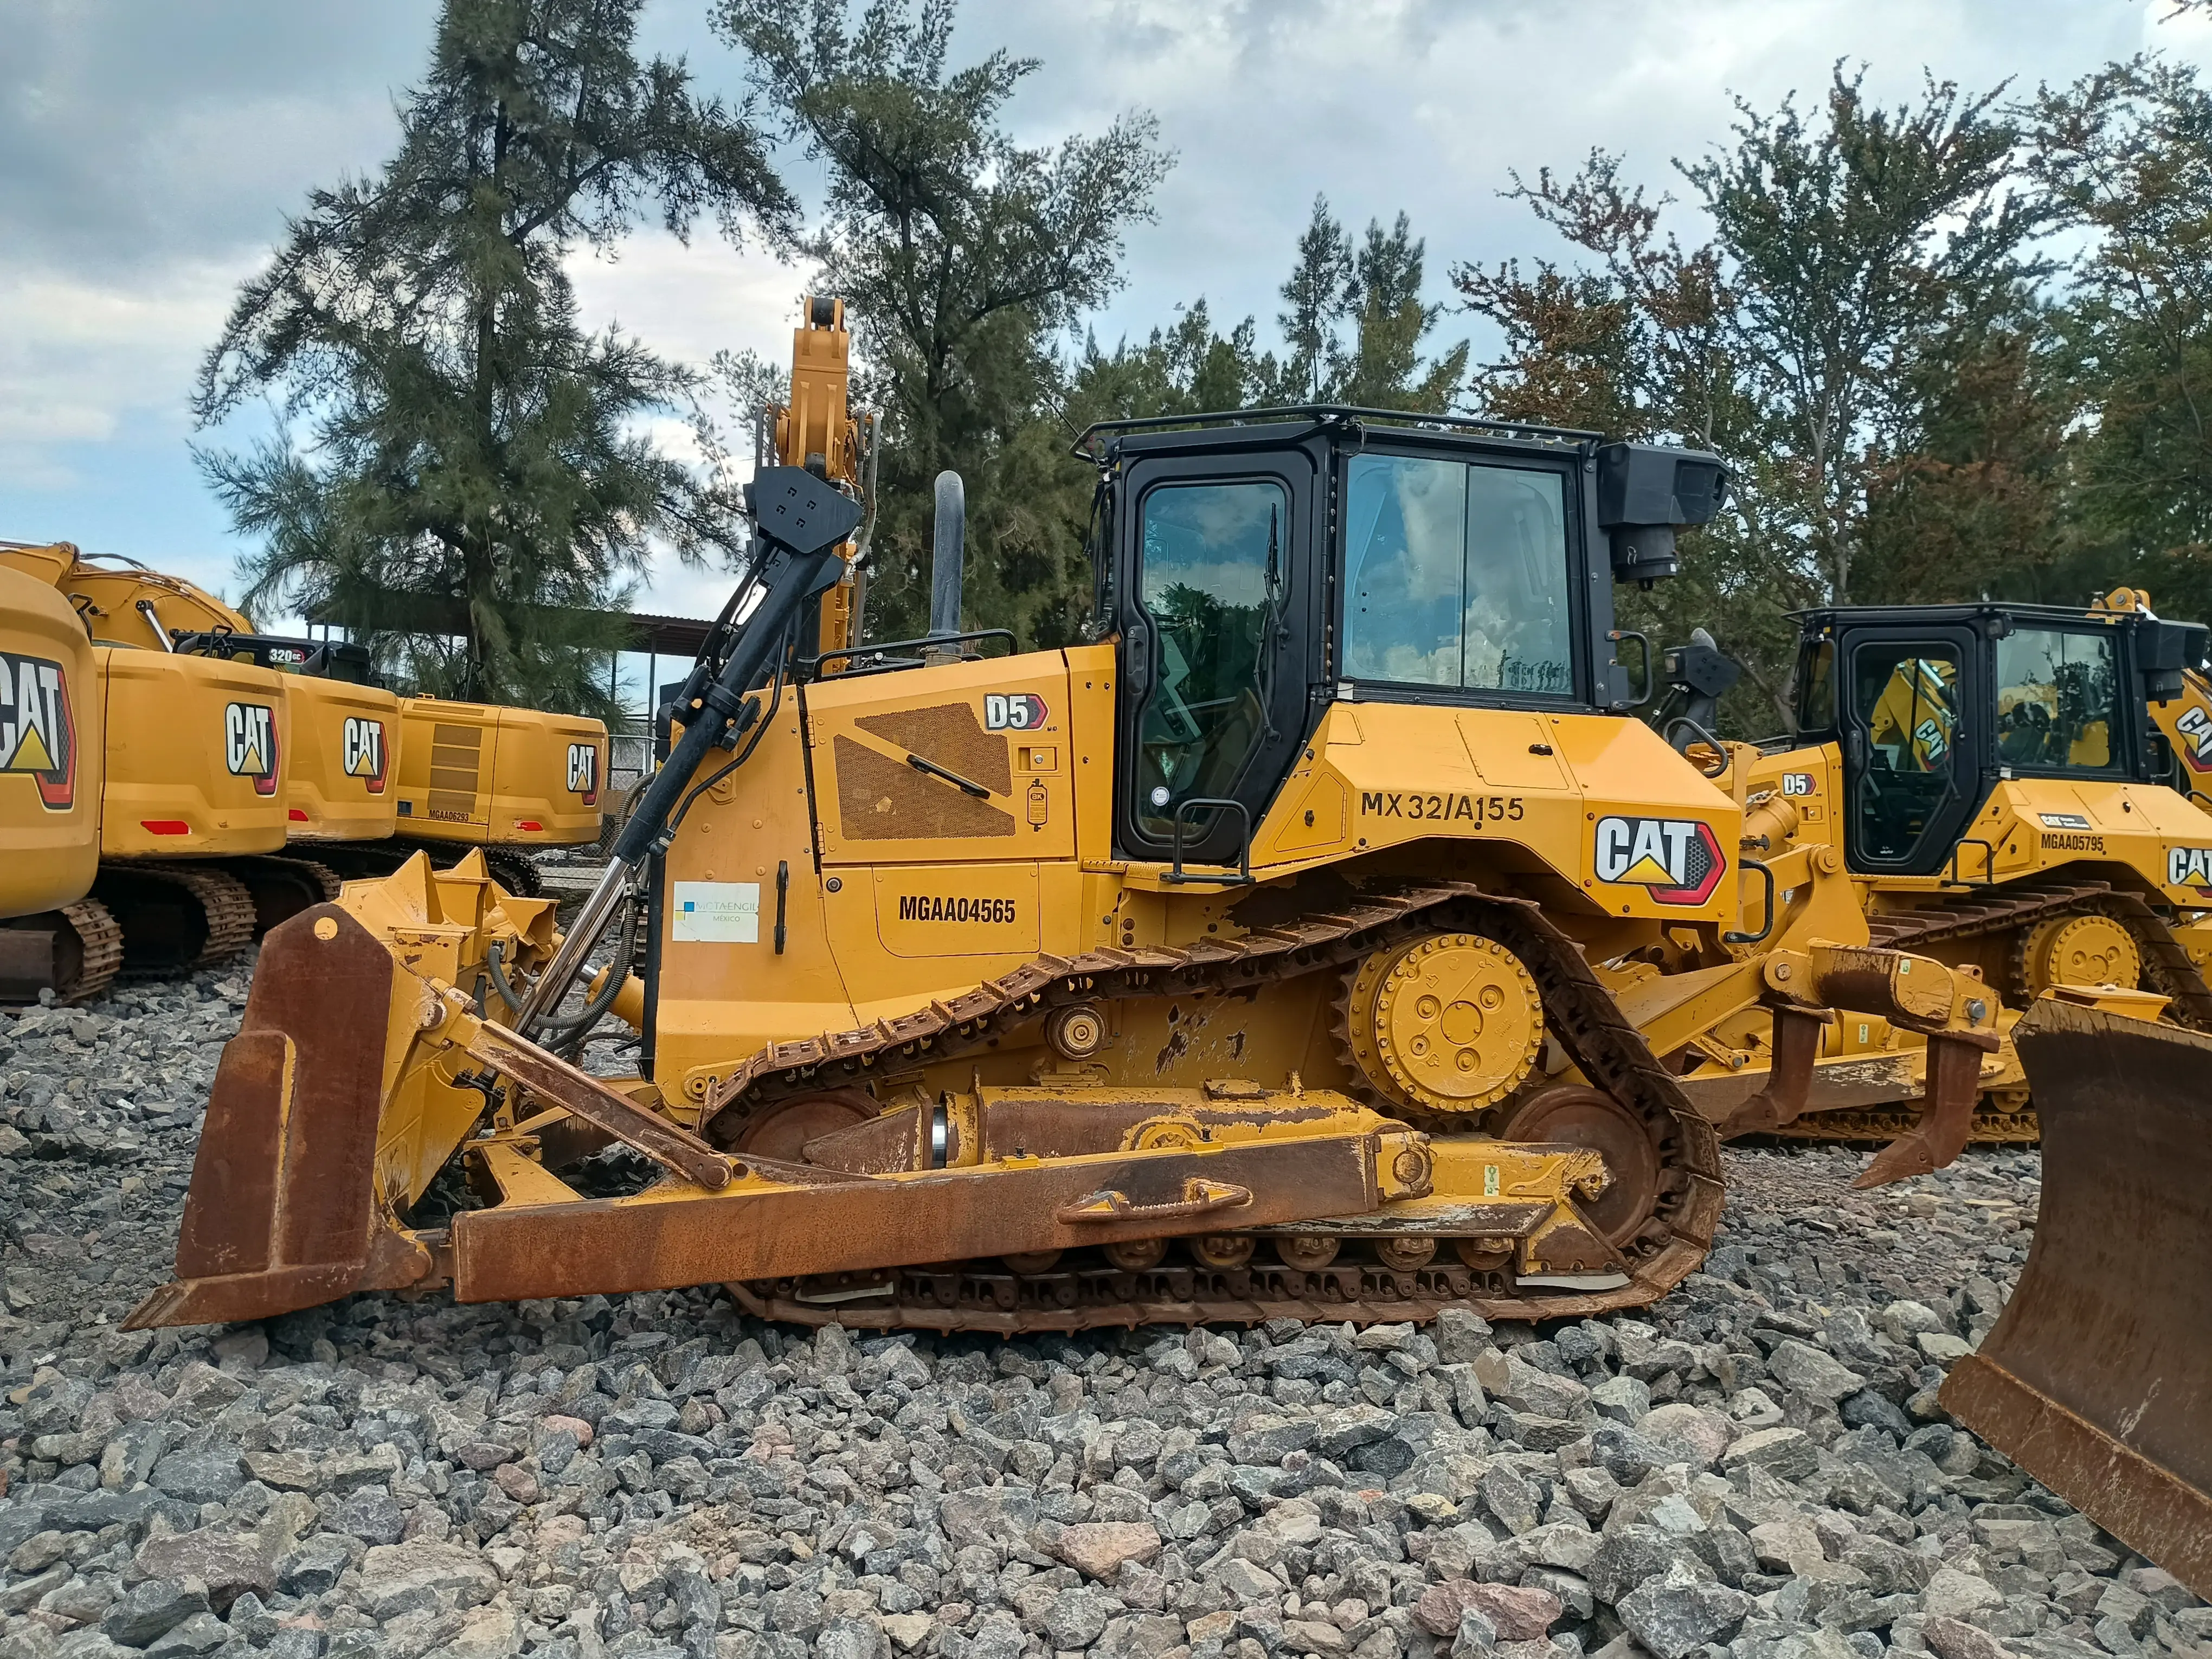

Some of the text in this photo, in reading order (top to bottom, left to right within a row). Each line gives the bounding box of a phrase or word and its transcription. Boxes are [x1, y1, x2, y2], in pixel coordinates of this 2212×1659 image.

[271, 648, 293, 662] 320
[986, 696, 1028, 728] D5
[226, 704, 269, 773] CAT
[344, 718, 380, 776] CAT
[1915, 719, 1949, 760] CAT
[567, 744, 594, 790] CAT
[1783, 774, 1806, 794] D5
[428, 809, 469, 822] MGAA06293
[1596, 818, 1695, 885] CAT
[2041, 833, 2104, 851] MGAA05795
[899, 896, 1015, 923] MGAA04565
